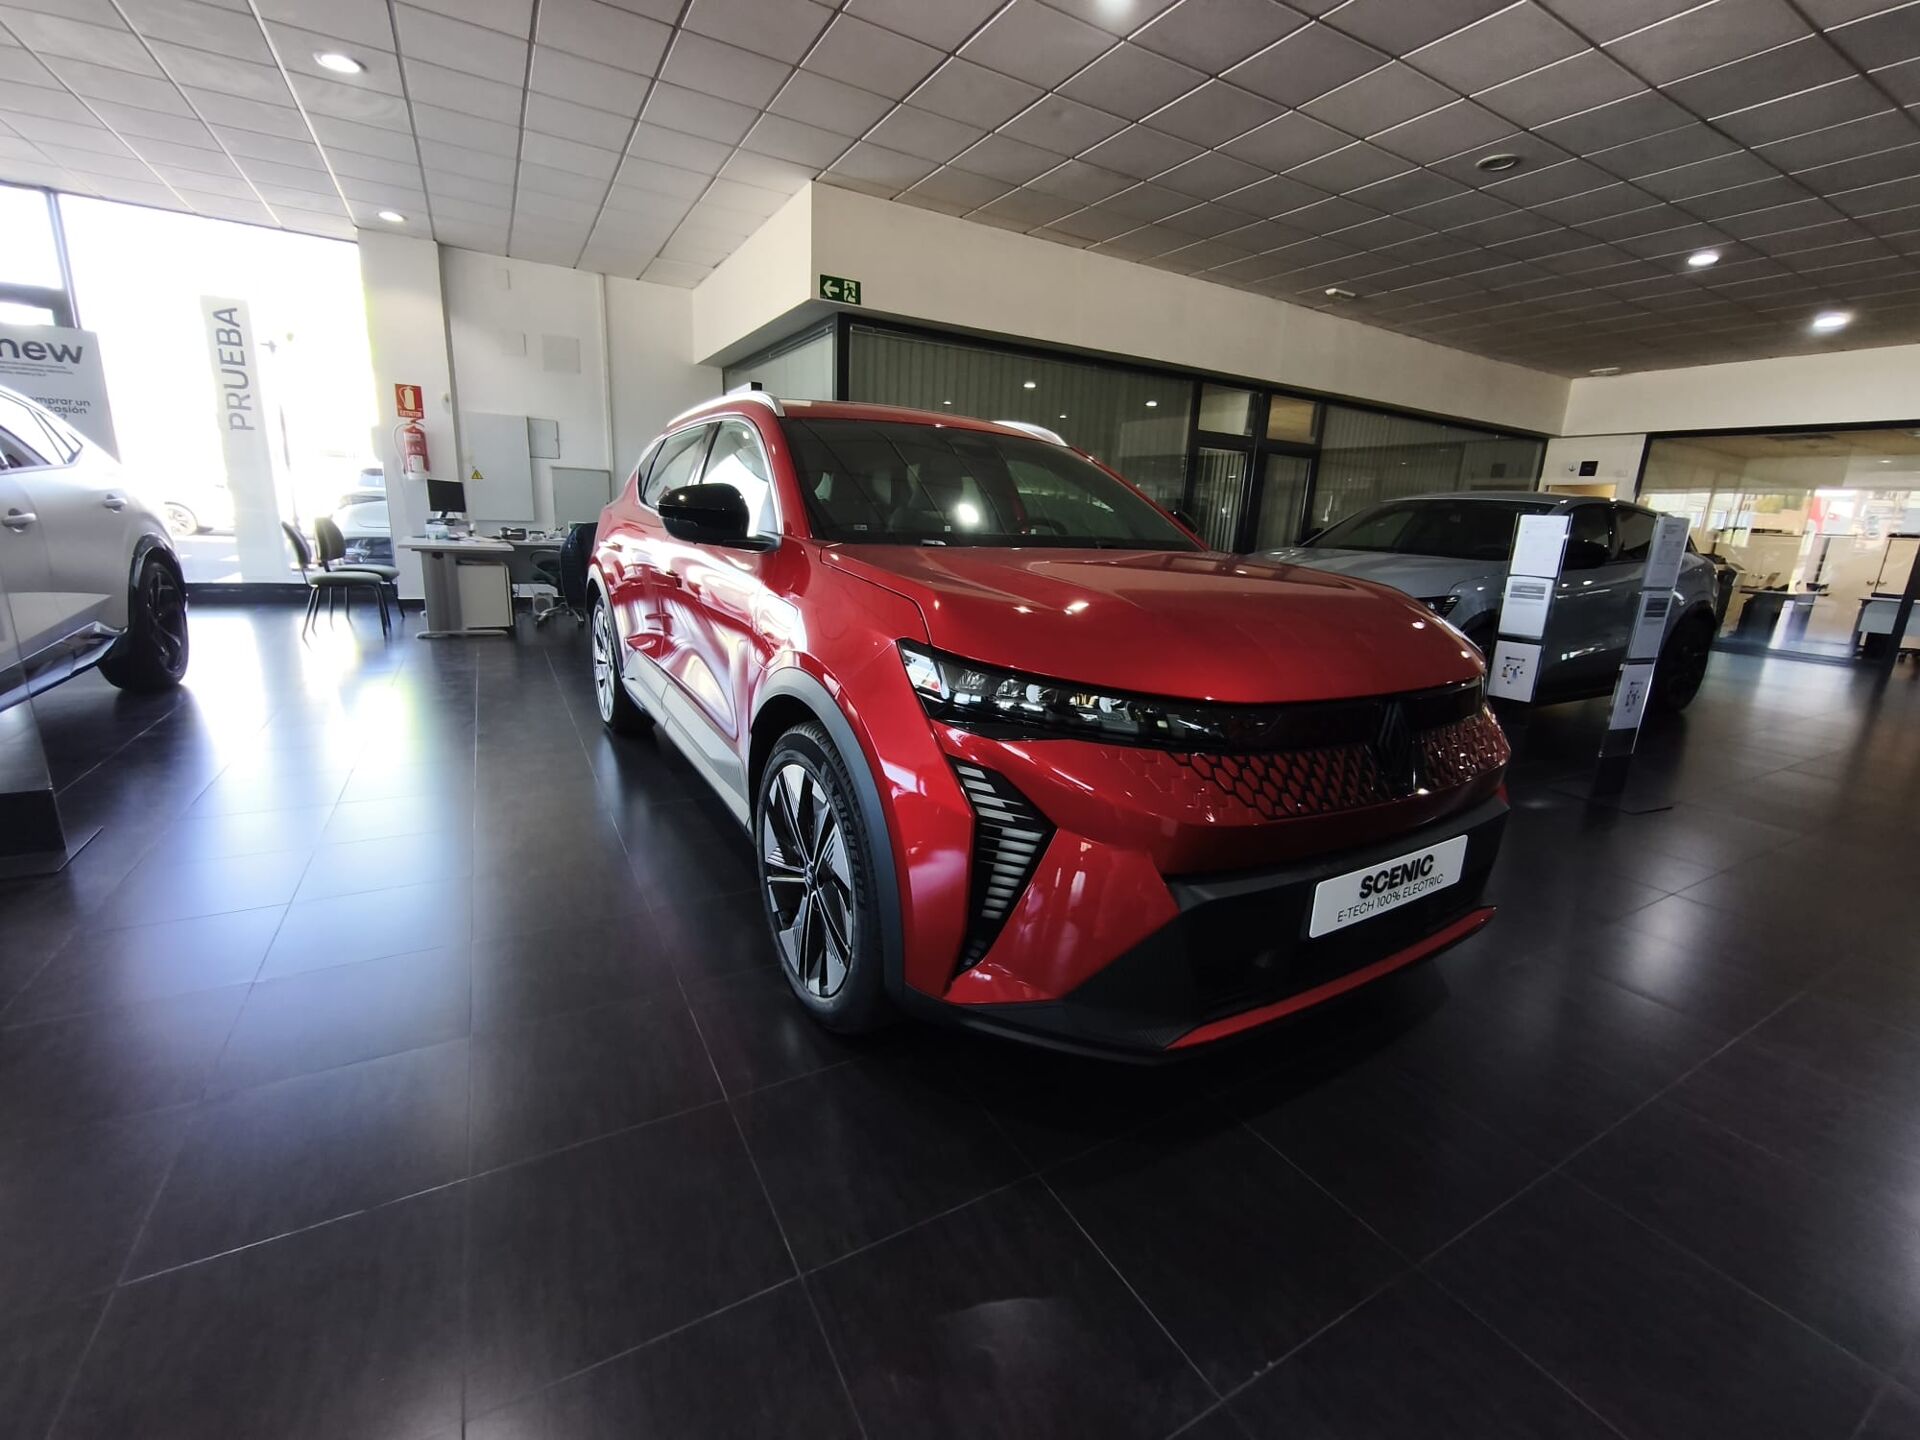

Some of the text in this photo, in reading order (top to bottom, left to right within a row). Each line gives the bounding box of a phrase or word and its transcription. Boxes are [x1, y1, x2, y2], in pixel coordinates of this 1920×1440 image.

[213, 307, 255, 431] PRUEBA
[29, 396, 74, 406] mprar
[834, 794, 865, 905] MICHELIN
[1337, 873, 1445, 923] E-TECH 100% ELECTRIC
[1359, 854, 1434, 899] SCENIC
